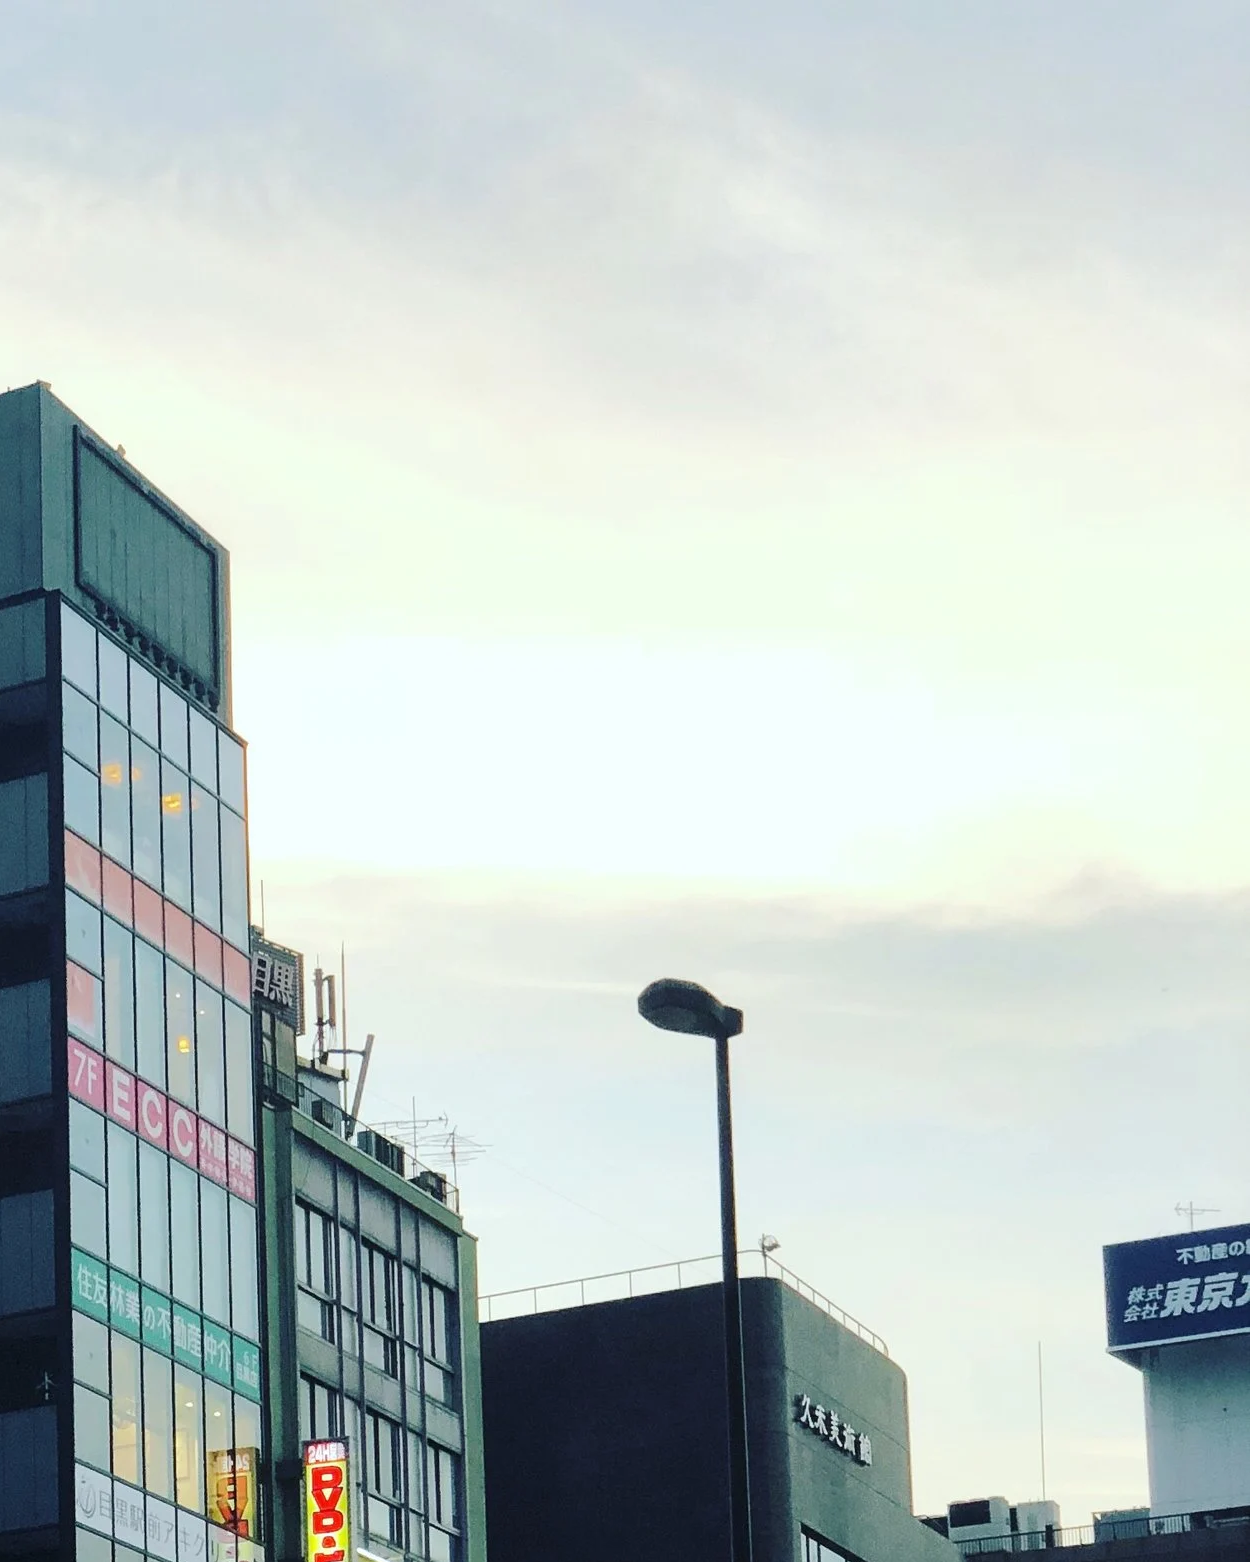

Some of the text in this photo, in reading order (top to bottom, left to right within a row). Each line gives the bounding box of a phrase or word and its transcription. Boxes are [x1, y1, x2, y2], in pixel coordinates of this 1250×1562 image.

[252, 954, 294, 1007] 目黒
[74, 1049, 98, 1095] 7F
[112, 1067, 194, 1158] ECC
[1175, 1238, 1250, 1266] 不動産の
[1123, 1302, 1160, 1323] 会社
[1127, 1283, 1164, 1305] 株式
[77, 1263, 231, 1372] 住友林業の不動産仲介
